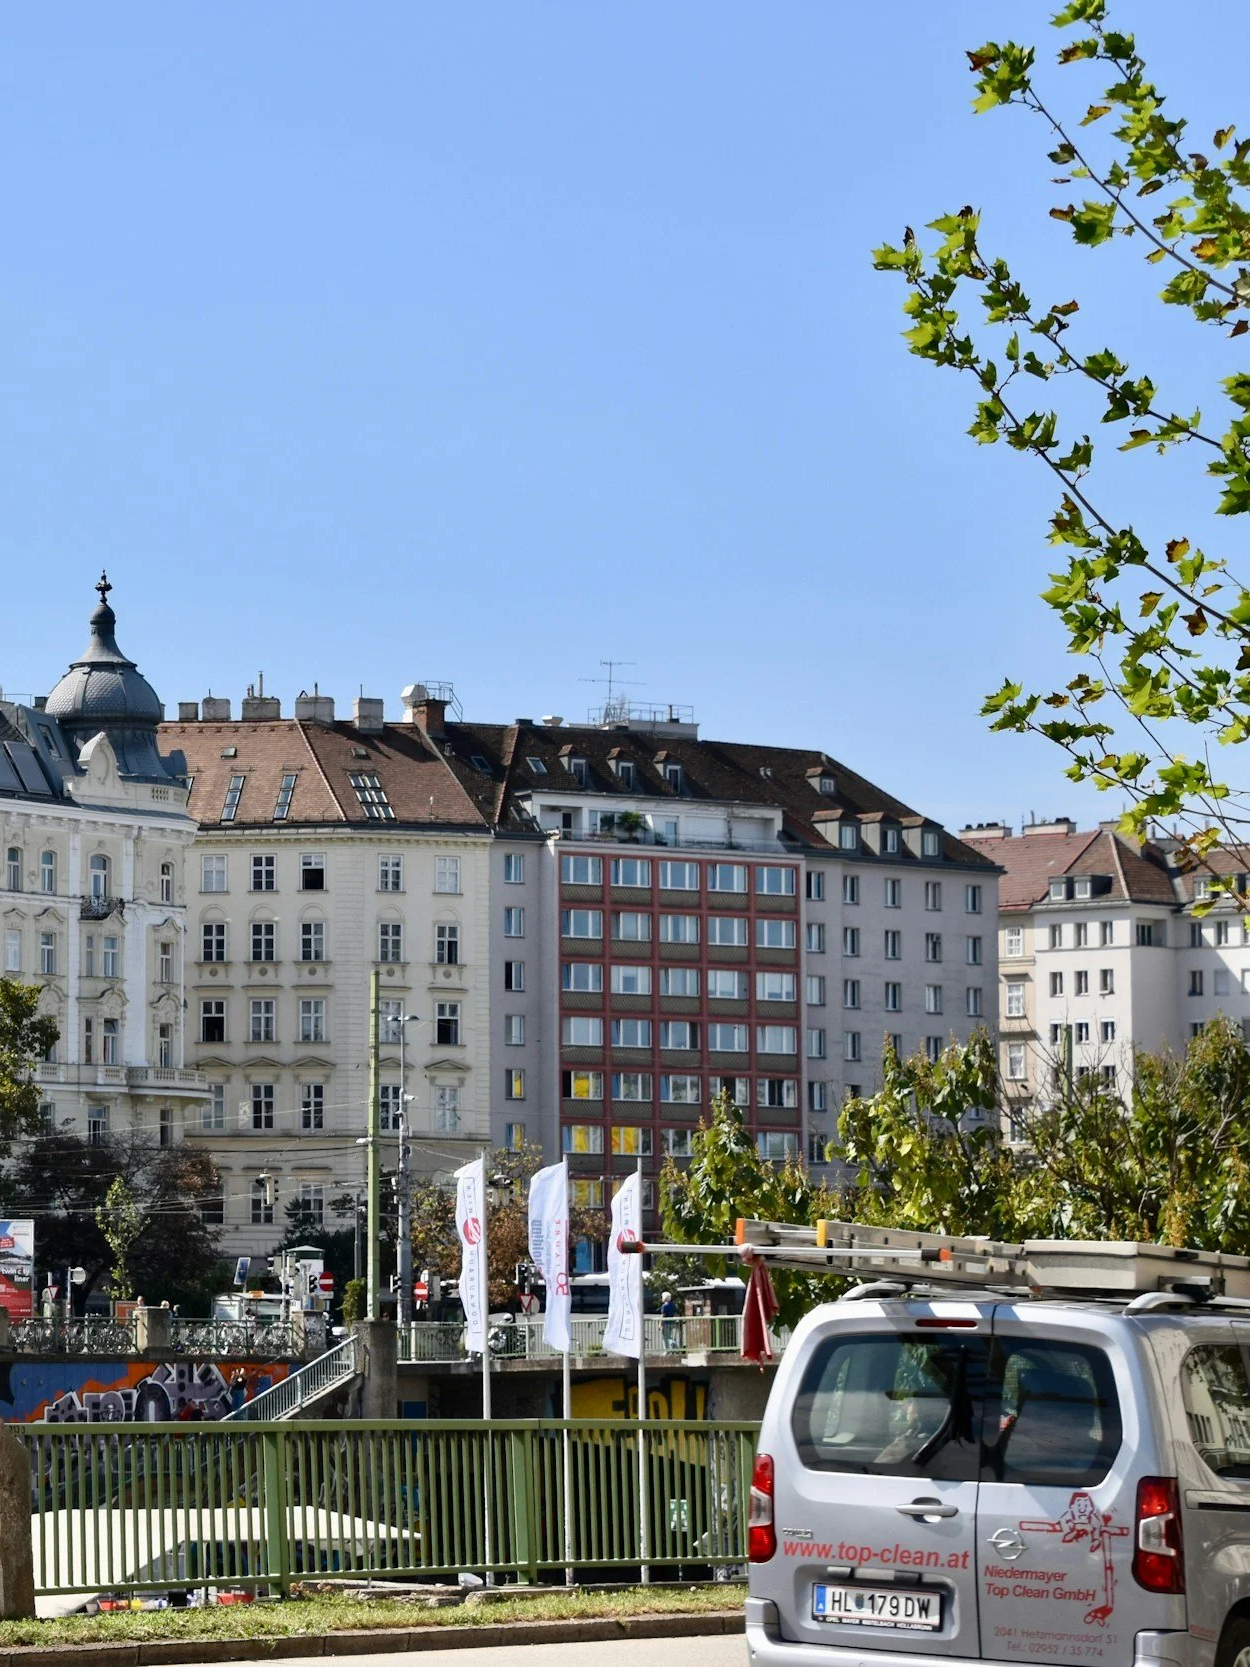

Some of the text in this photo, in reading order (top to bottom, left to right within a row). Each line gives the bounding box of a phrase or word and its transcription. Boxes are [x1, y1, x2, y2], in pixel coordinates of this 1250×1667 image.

[783, 1540, 970, 1570] www.top-clean.at
[984, 1565, 1068, 1584] Niedermayer
[986, 1583, 1096, 1602] Top Clean GmbH
[831, 1591, 930, 1619] HL 179 DW
